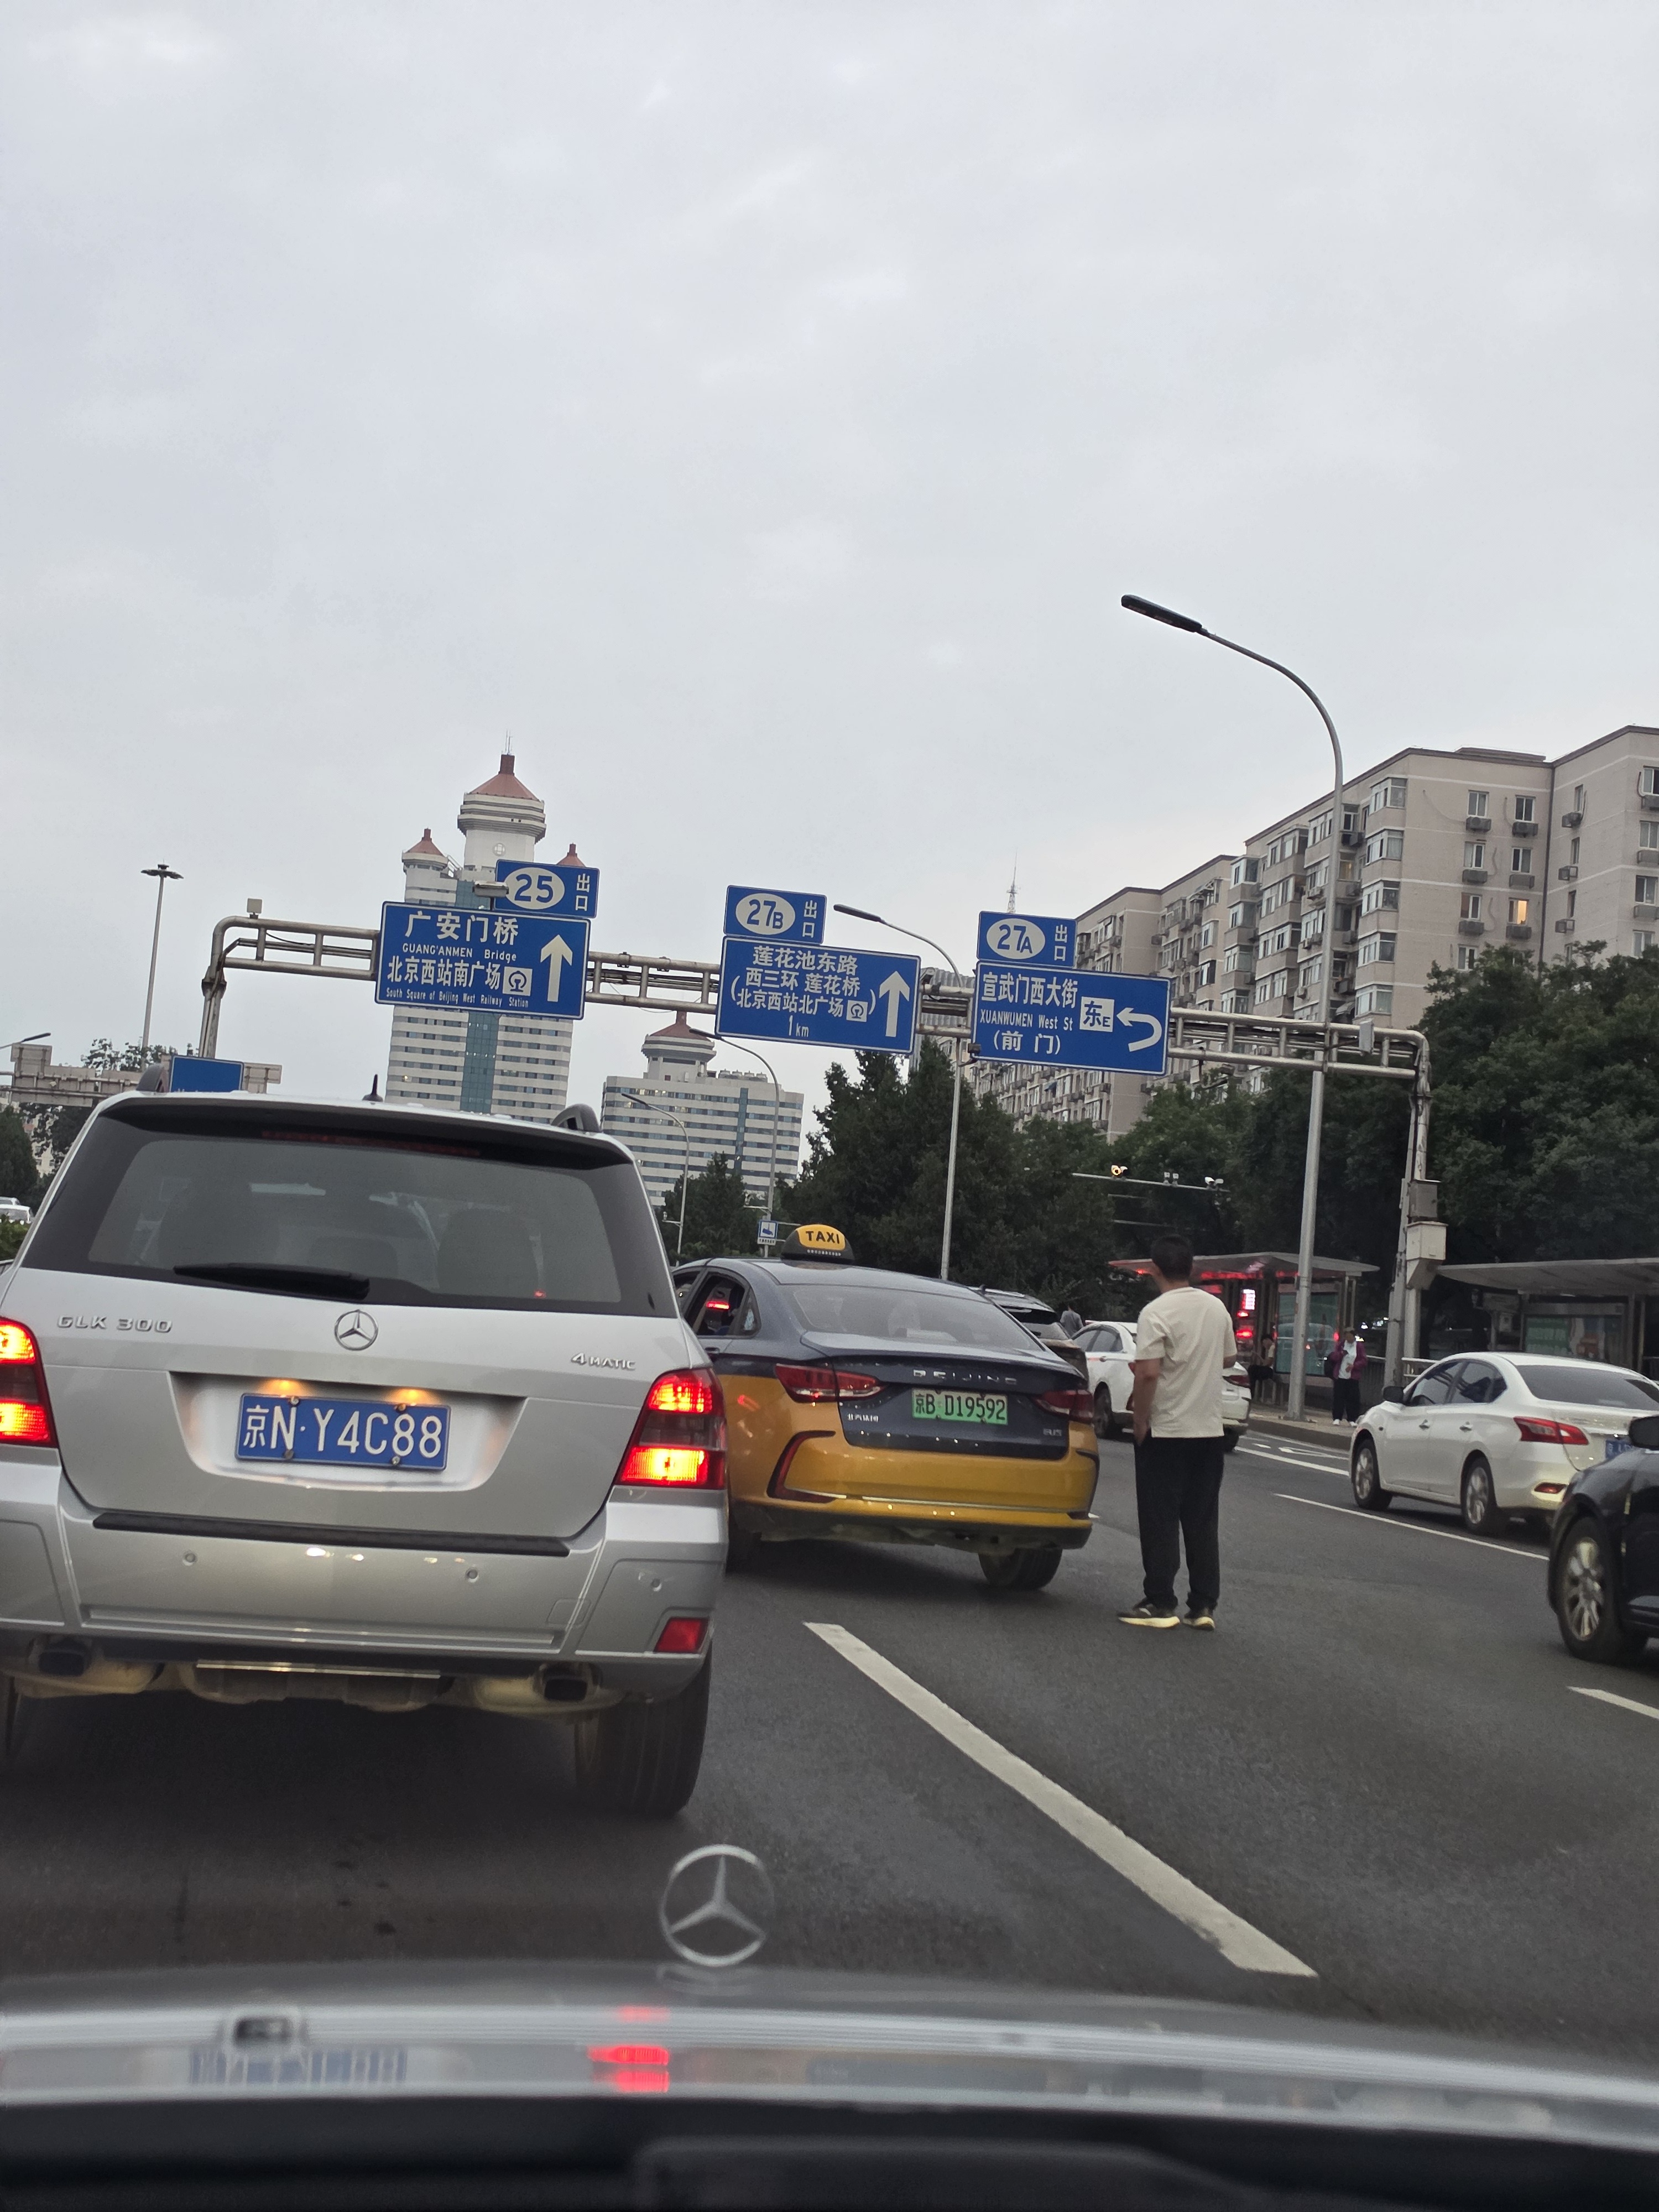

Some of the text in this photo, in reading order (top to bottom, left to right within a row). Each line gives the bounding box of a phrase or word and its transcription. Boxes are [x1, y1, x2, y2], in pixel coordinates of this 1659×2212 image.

[514, 874, 554, 903] 25
[575, 873, 591, 911] 出口
[404, 911, 519, 946] 广安门桥
[747, 899, 784, 930] 27B
[802, 900, 817, 938] 出口
[403, 943, 517, 964] GUANG'ANMEN Bridge
[997, 924, 1033, 954] 27A
[1053, 924, 1068, 962] 出口
[387, 956, 501, 990] 北京西站南广场
[753, 945, 858, 975] 莲花池东路
[387, 987, 529, 1008] South Square of Beijing West Railway Station
[981, 972, 1078, 1009] 宣武门西大街
[980, 1009, 1073, 1031] XUANWUMEN West St
[806, 1230, 839, 1244] TAXI
[57, 1316, 173, 1333] GLK 300
